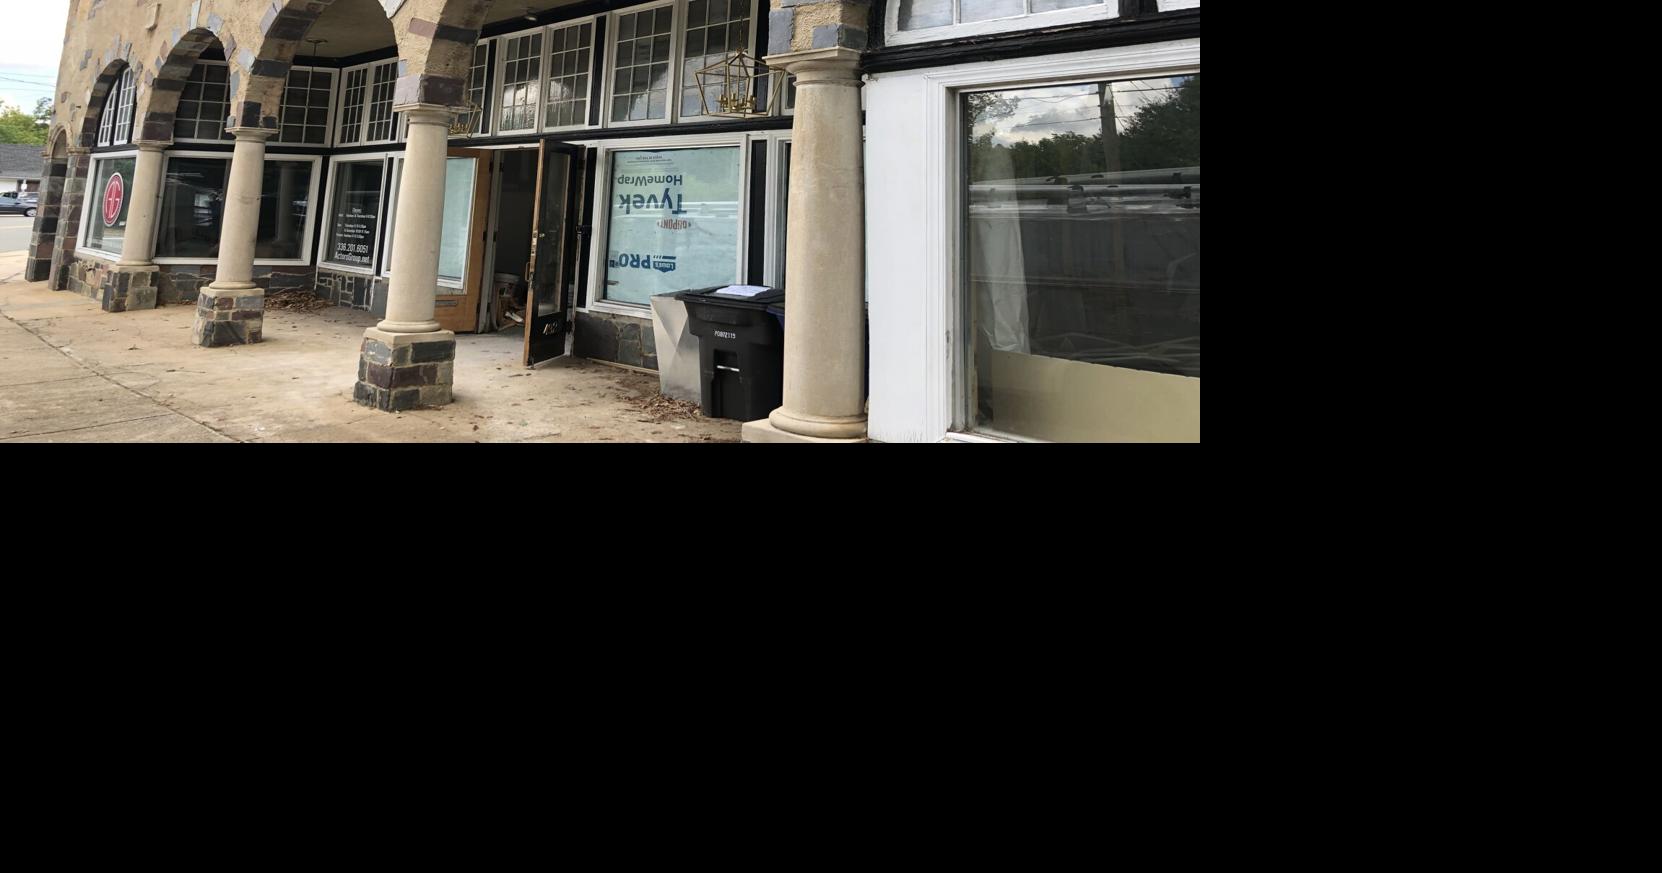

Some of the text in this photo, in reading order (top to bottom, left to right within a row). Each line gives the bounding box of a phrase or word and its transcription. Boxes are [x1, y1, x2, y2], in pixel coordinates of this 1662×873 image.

[617, 175, 682, 186] HomeWrap
[619, 188, 687, 214] Tyvek
[618, 253, 650, 269] PRO
